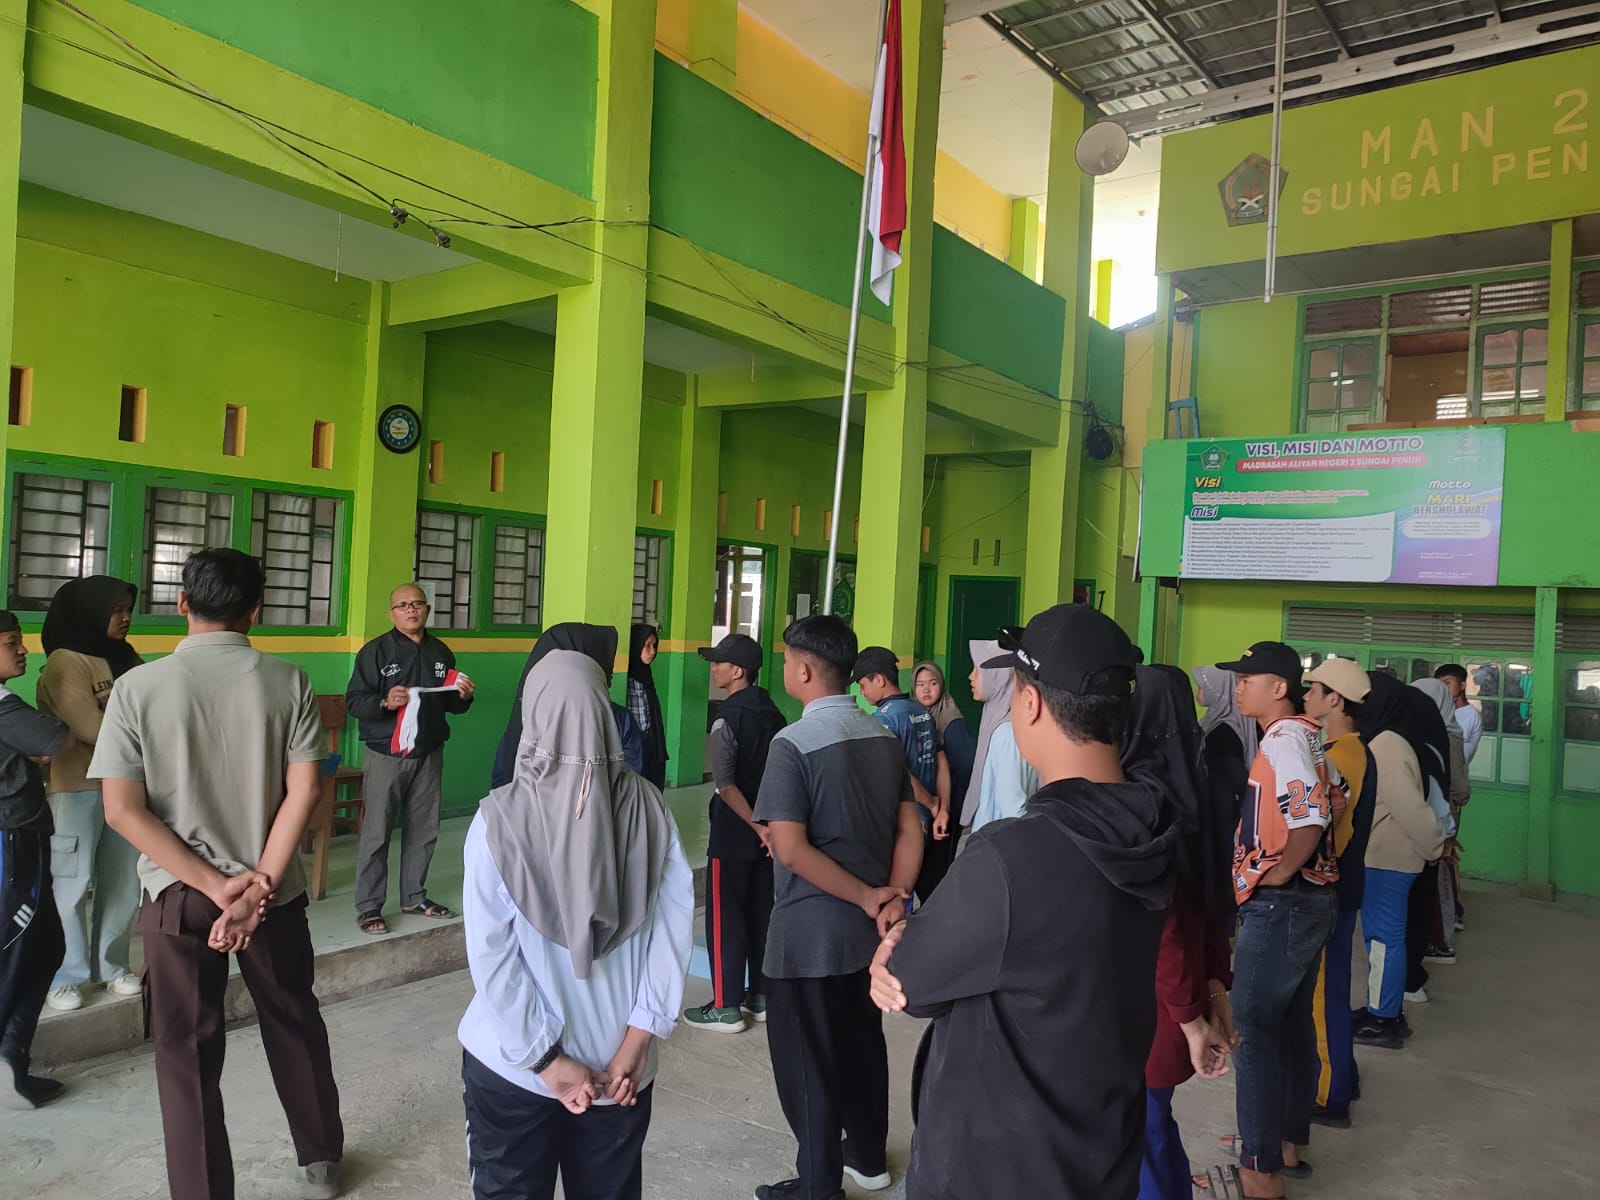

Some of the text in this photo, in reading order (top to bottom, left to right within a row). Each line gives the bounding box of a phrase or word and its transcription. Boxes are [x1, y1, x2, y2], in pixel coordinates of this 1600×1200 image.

[1361, 88, 1589, 168] MAN 2
[1301, 161, 1459, 216] SUNGAI
[1246, 436, 1423, 458] VISI, MISI DAN MOTTO
[1242, 461, 1287, 470] MADRASAH
[1288, 460, 1317, 469] ALIYAH
[1319, 458, 1348, 468] NEGERI
[1357, 456, 1389, 466] SUNGAI
[1194, 476, 1222, 488] Visi
[1427, 480, 1472, 489] Motto
[1426, 494, 1472, 505] MARI
[1190, 506, 1219, 518] Misi
[1286, 778, 1331, 820] 24
